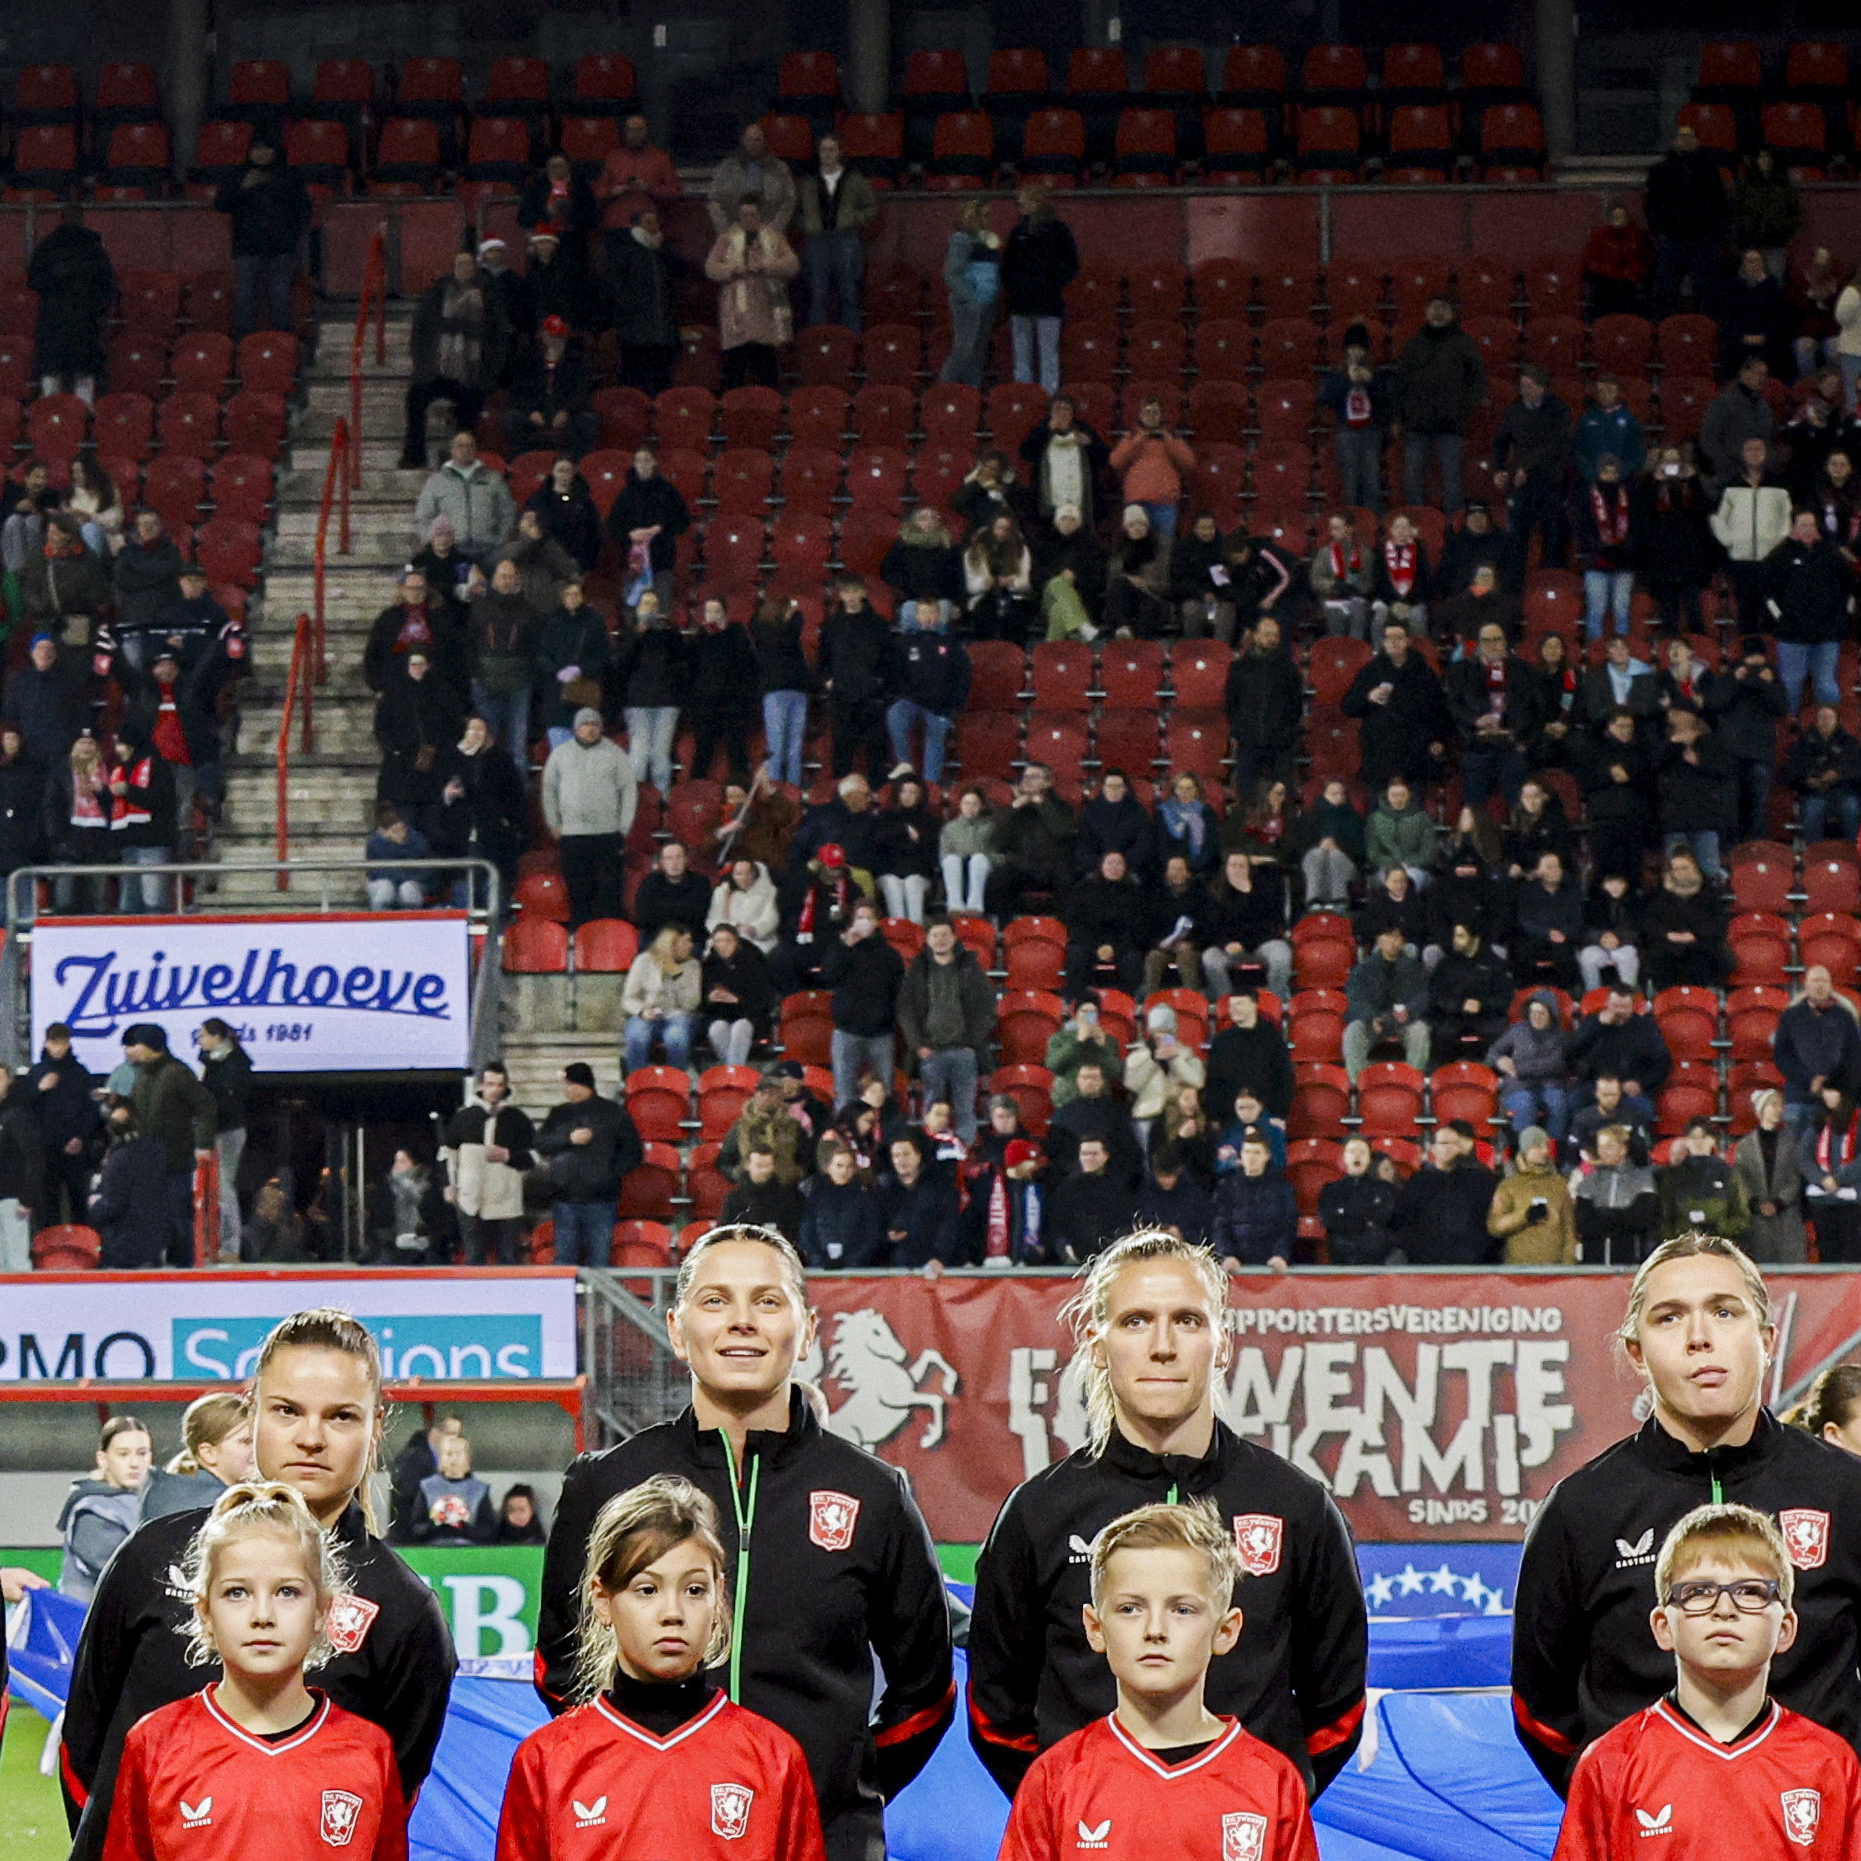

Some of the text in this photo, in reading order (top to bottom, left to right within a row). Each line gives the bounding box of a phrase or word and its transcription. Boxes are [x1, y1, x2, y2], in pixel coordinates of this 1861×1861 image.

[55, 949, 450, 1038] Zuivelhoeve
[184, 1328, 530, 1379] Sions
[1408, 1499, 1488, 1524] SINDS
